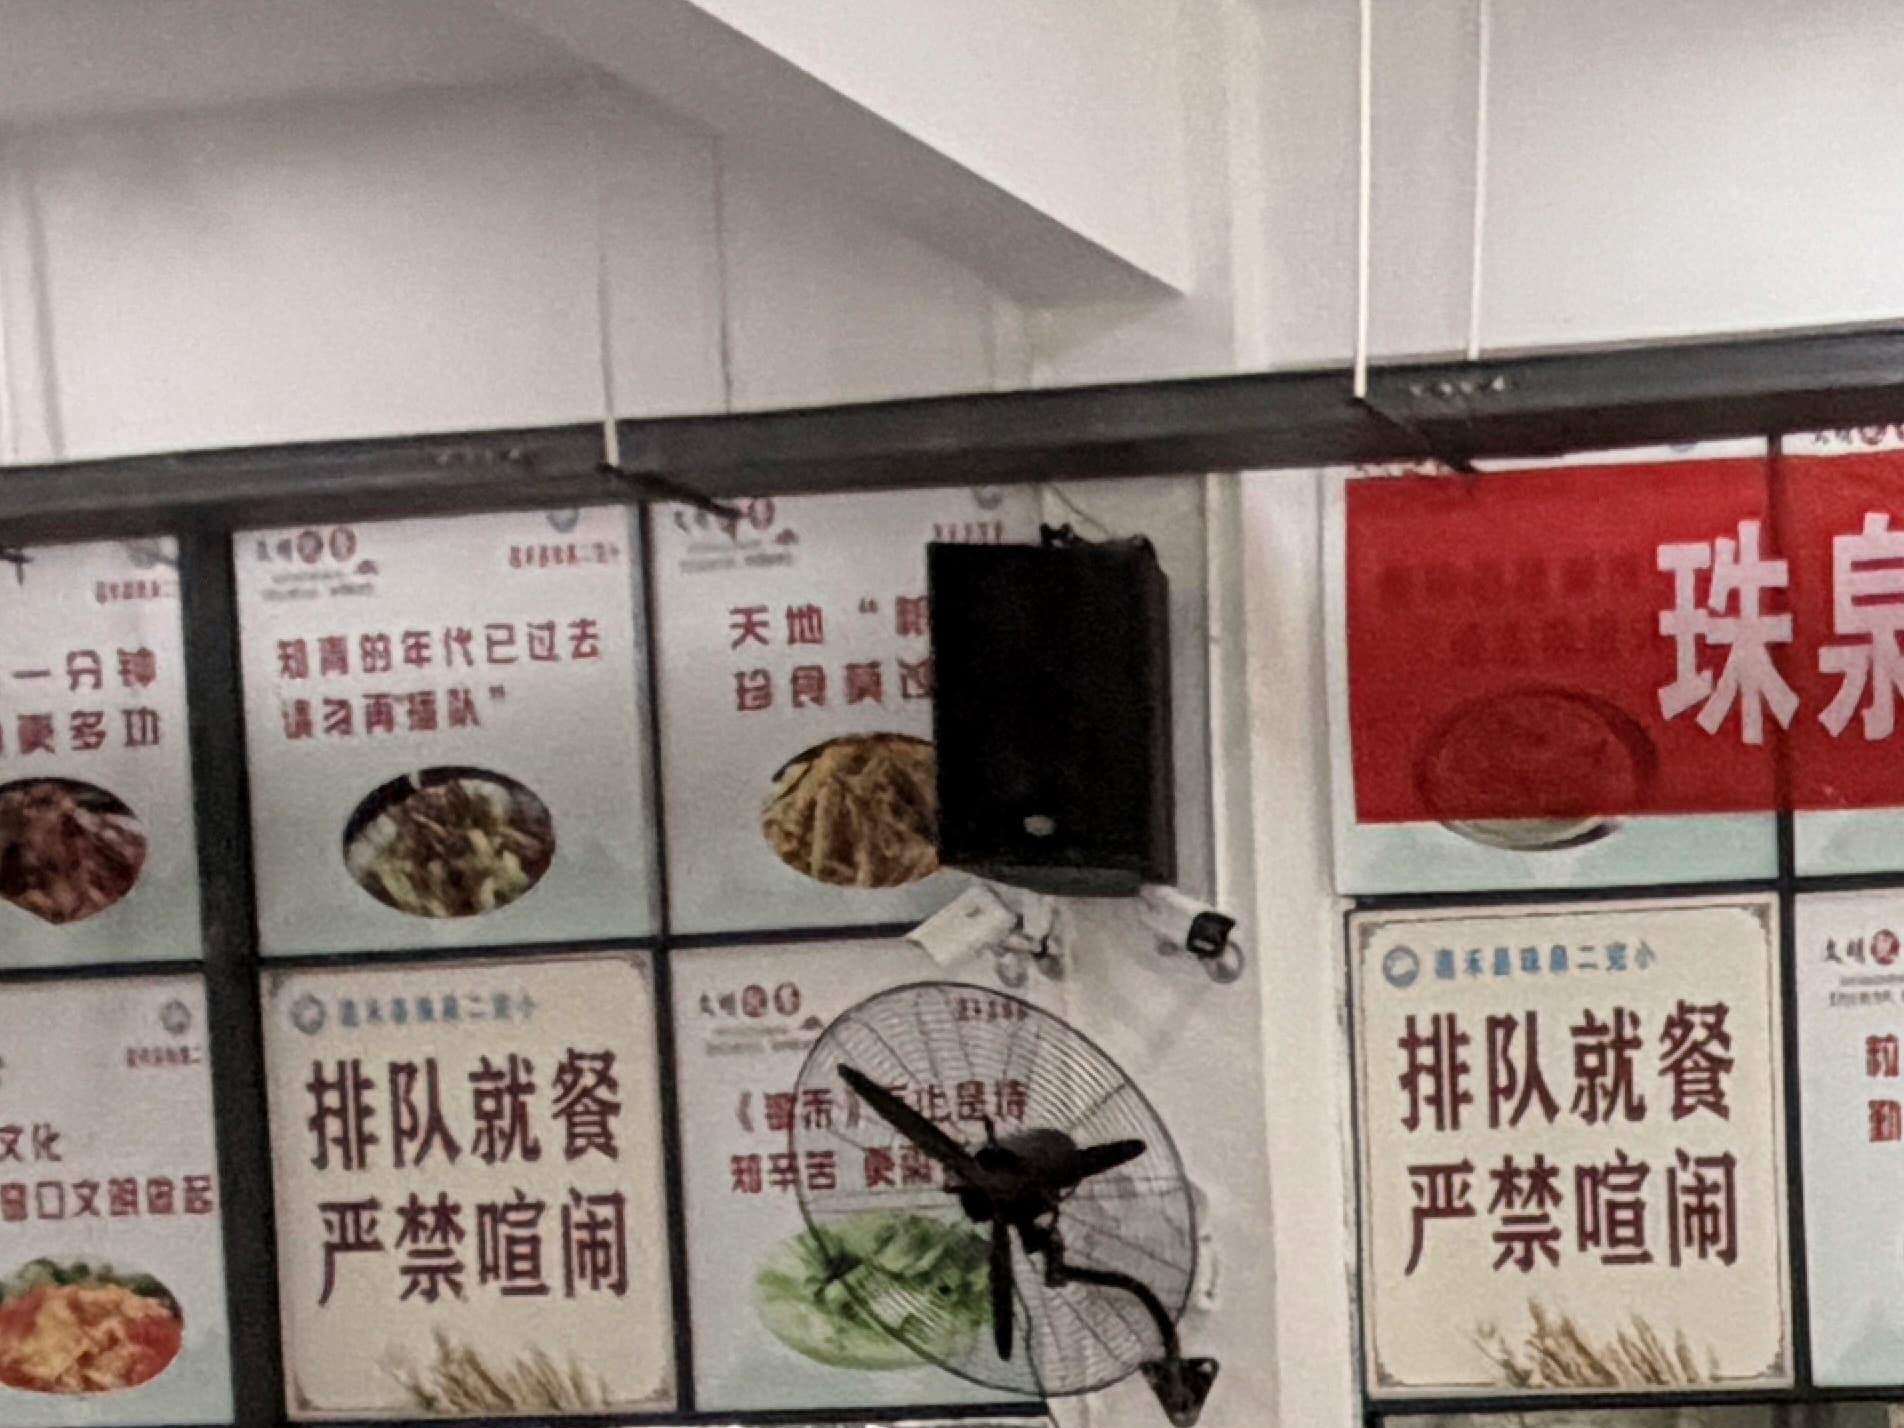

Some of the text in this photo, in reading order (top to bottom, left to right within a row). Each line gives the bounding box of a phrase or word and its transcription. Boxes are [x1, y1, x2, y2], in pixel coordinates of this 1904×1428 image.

[307, 1047, 623, 1171] 排队就餐
[1397, 999, 1736, 1134] 排队就餐
[315, 1186, 631, 1306] 严禁喧闹
[1404, 1147, 1739, 1276] 严禁喧闹
